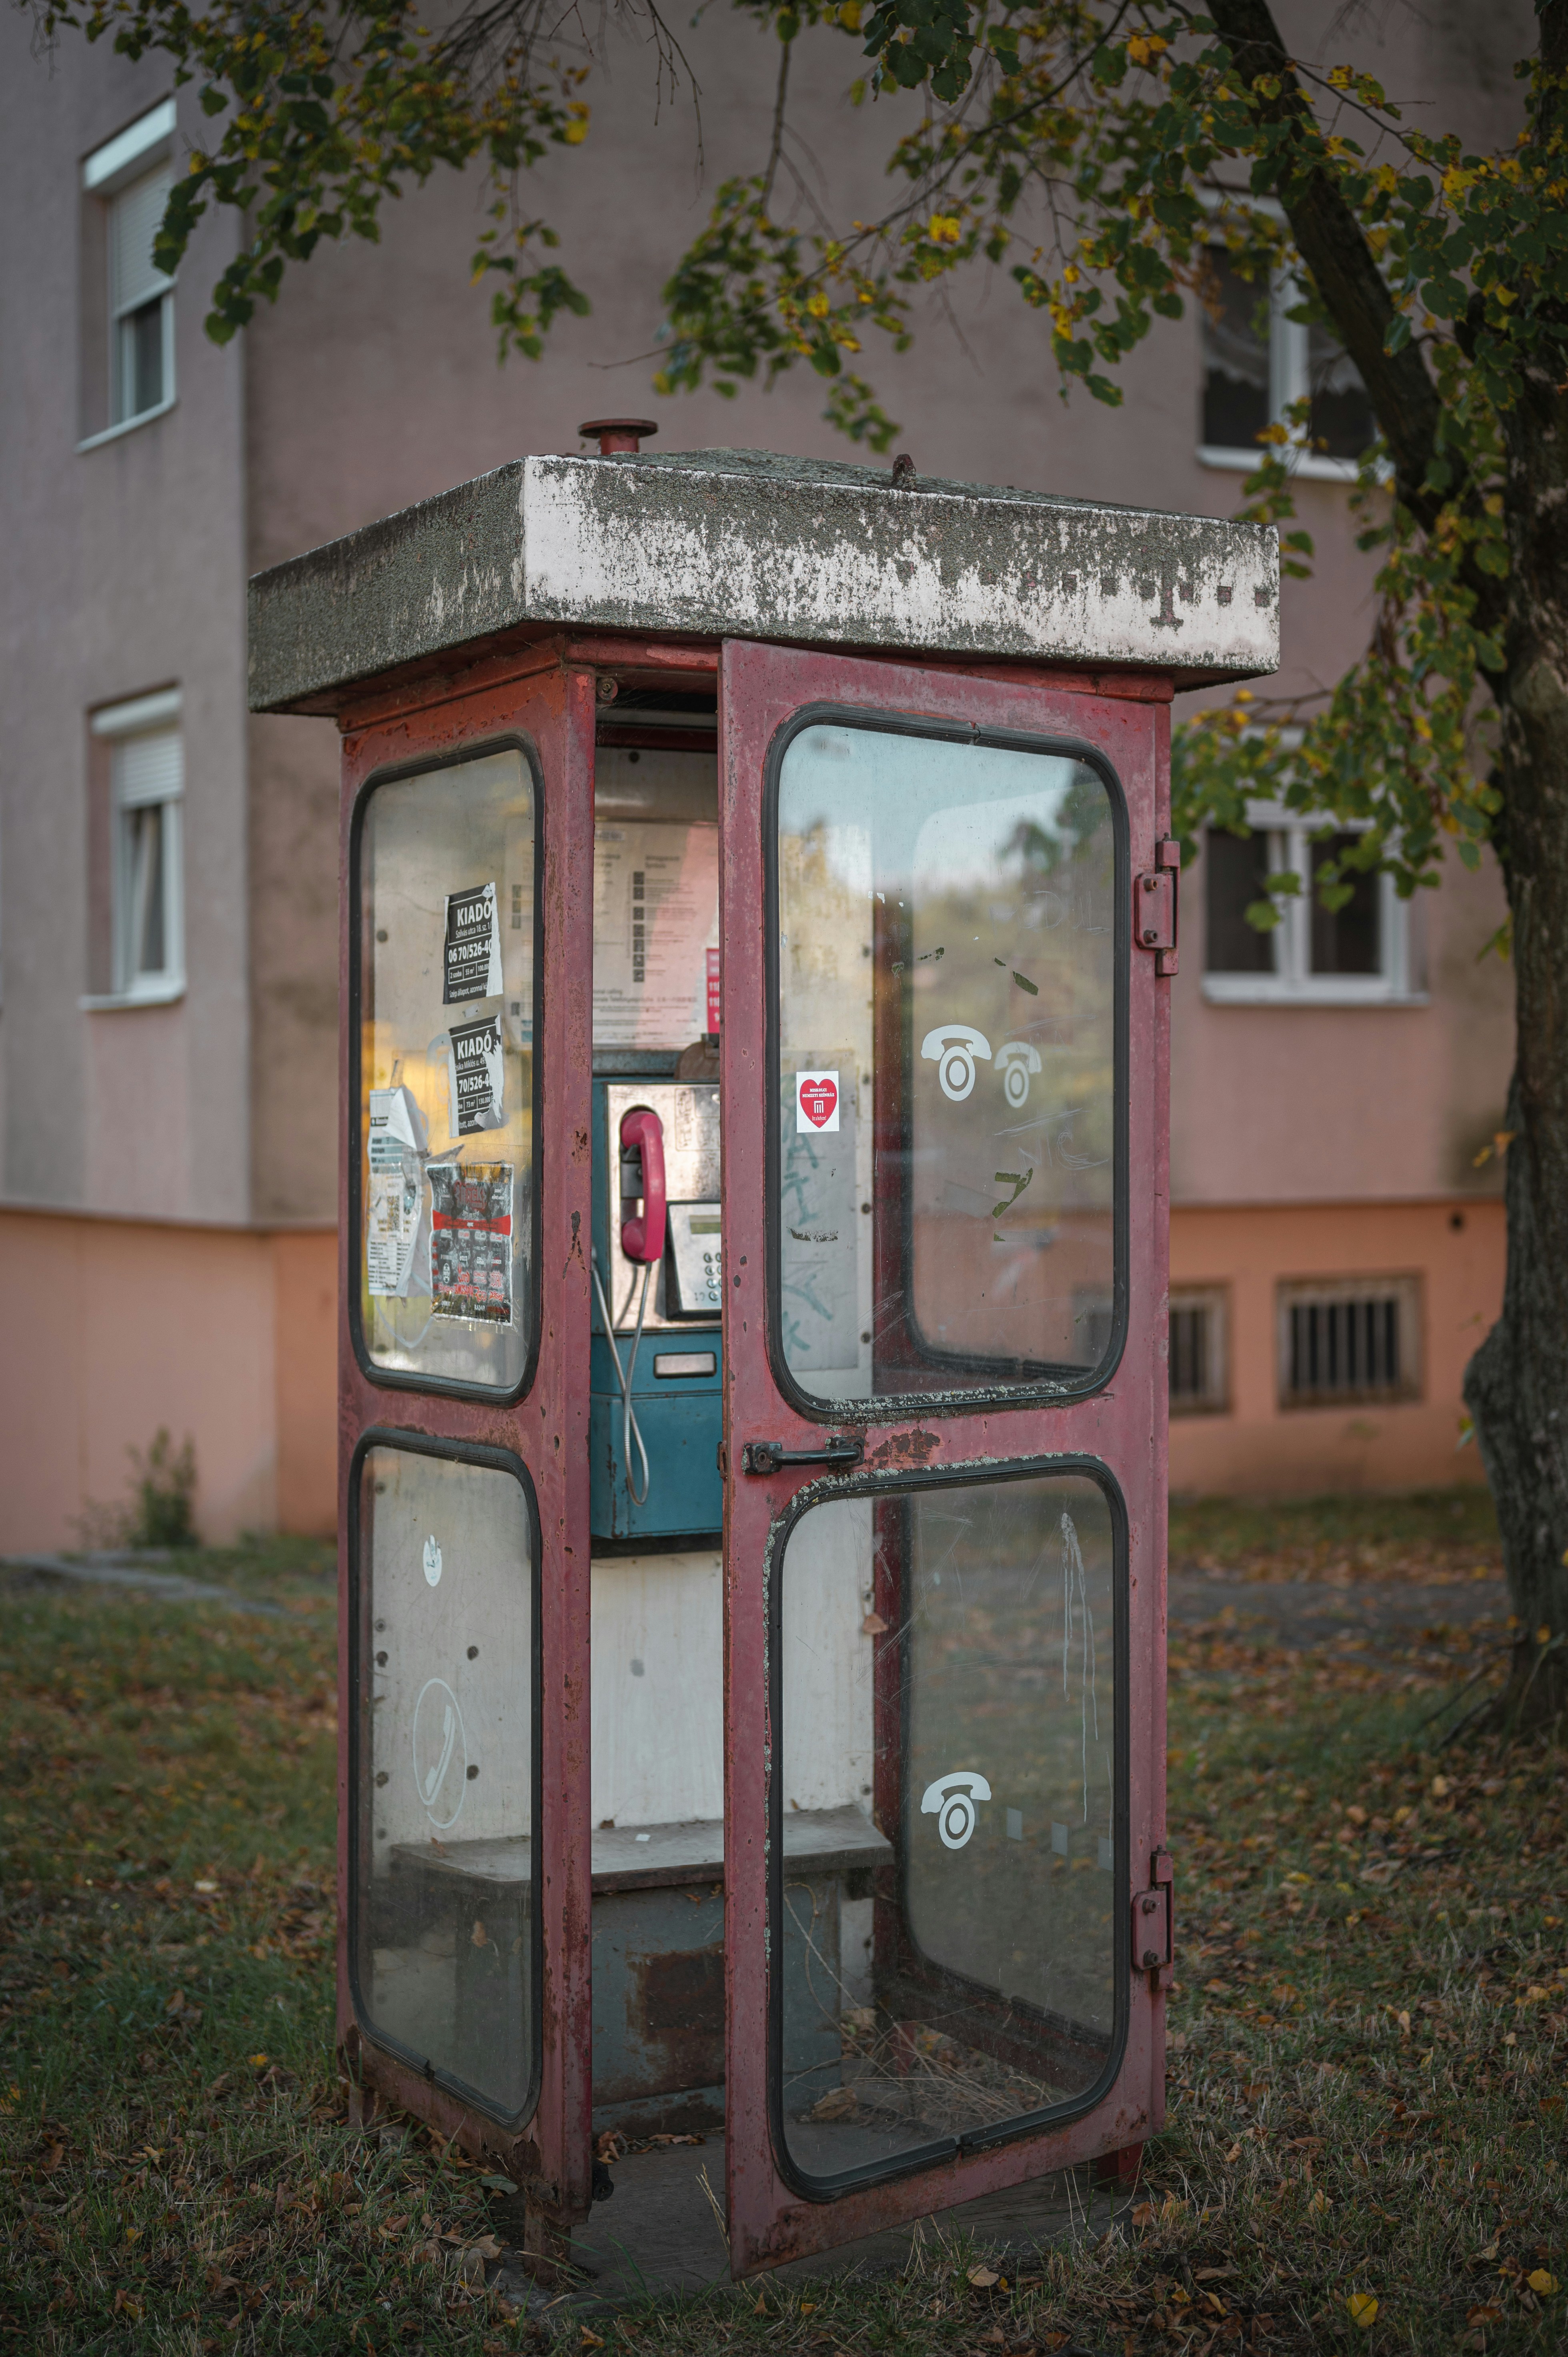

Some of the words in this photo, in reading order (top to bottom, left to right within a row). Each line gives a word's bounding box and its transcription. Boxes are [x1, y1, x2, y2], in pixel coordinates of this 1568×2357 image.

[457, 898, 491, 927] KIADÓ
[456, 928, 467, 938] Szilvás
[468, 927, 476, 936] utca
[449, 948, 457, 963] 06
[449, 990, 457, 998] Szép
[470, 983, 483, 993] azonnal
[457, 1030, 492, 1060] KIADÓ
[464, 1059, 475, 1068] Miklós
[479, 1096, 491, 1104] 130.000
